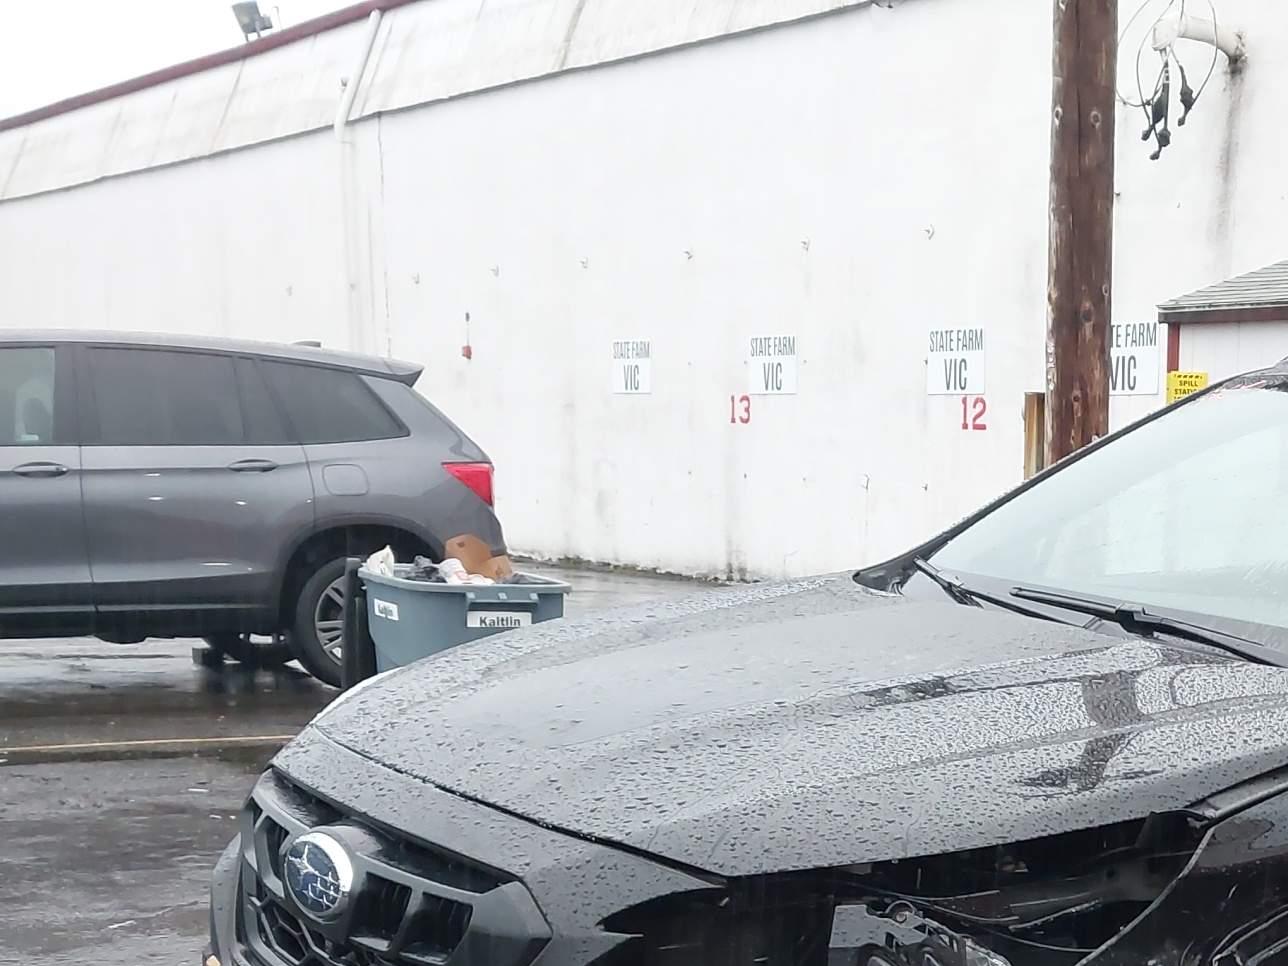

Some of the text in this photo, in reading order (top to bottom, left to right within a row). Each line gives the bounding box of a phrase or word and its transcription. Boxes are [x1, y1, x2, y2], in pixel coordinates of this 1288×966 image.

[750, 336, 796, 357] STATE FARM
[929, 328, 984, 353] STATE FARM
[1125, 323, 1158, 347] FARM
[612, 340, 651, 360] STATE FARM
[623, 364, 640, 391] VIC
[763, 362, 783, 391] VIC
[944, 358, 968, 391] VIC
[1110, 355, 1137, 391] VIC
[730, 395, 751, 424] 13
[961, 396, 987, 430] 12
